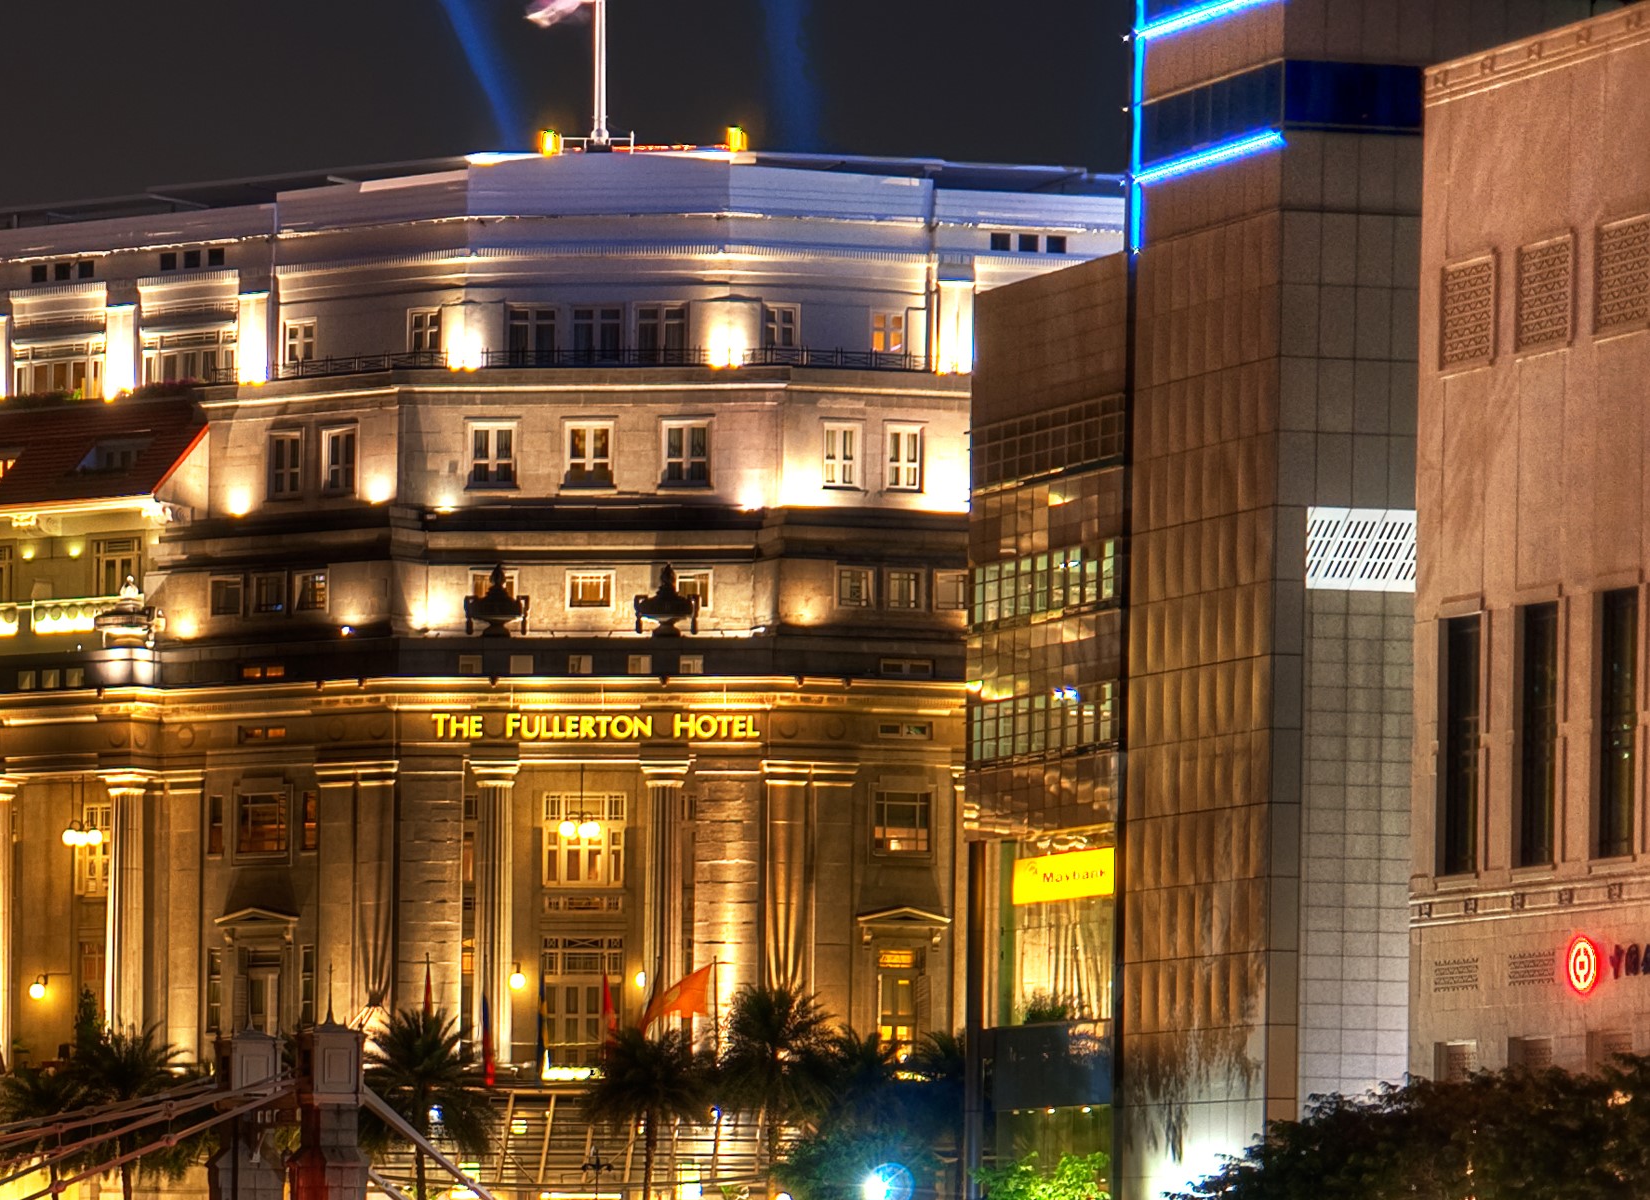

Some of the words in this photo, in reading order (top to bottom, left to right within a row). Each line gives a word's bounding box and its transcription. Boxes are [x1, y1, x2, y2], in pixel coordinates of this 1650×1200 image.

[431, 713, 483, 738] THE
[505, 712, 652, 739] FULLERTON
[673, 713, 760, 738] HOTEL
